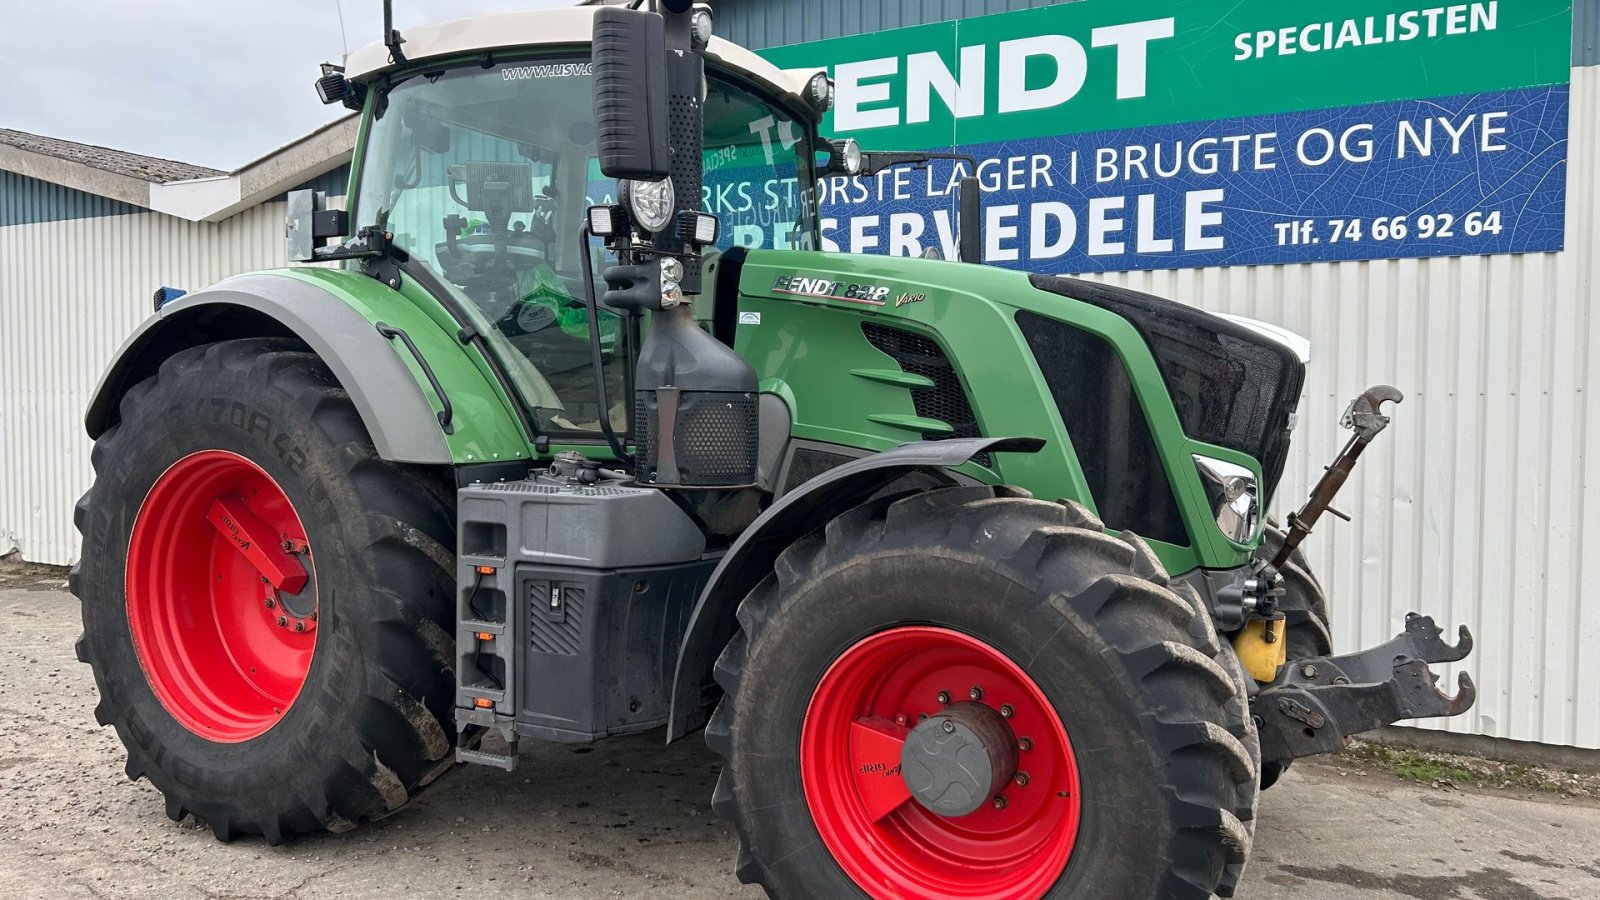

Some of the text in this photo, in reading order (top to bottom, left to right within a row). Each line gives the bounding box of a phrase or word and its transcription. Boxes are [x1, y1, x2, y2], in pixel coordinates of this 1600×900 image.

[1233, 1, 1498, 61] SPECIALISTEN
[780, 17, 1175, 131] ENDT
[927, 153, 1054, 197] LAGER
[1070, 151, 1077, 185] I
[1095, 132, 1277, 182] BRUGTE
[1296, 123, 1374, 166] OG
[1398, 112, 1508, 158] NYE
[1274, 211, 1502, 246] Tlf. 74 66 92 64
[773, 275, 845, 297] FENDT
[845, 282, 890, 301] 828
[858, 762, 887, 774] GRIP
